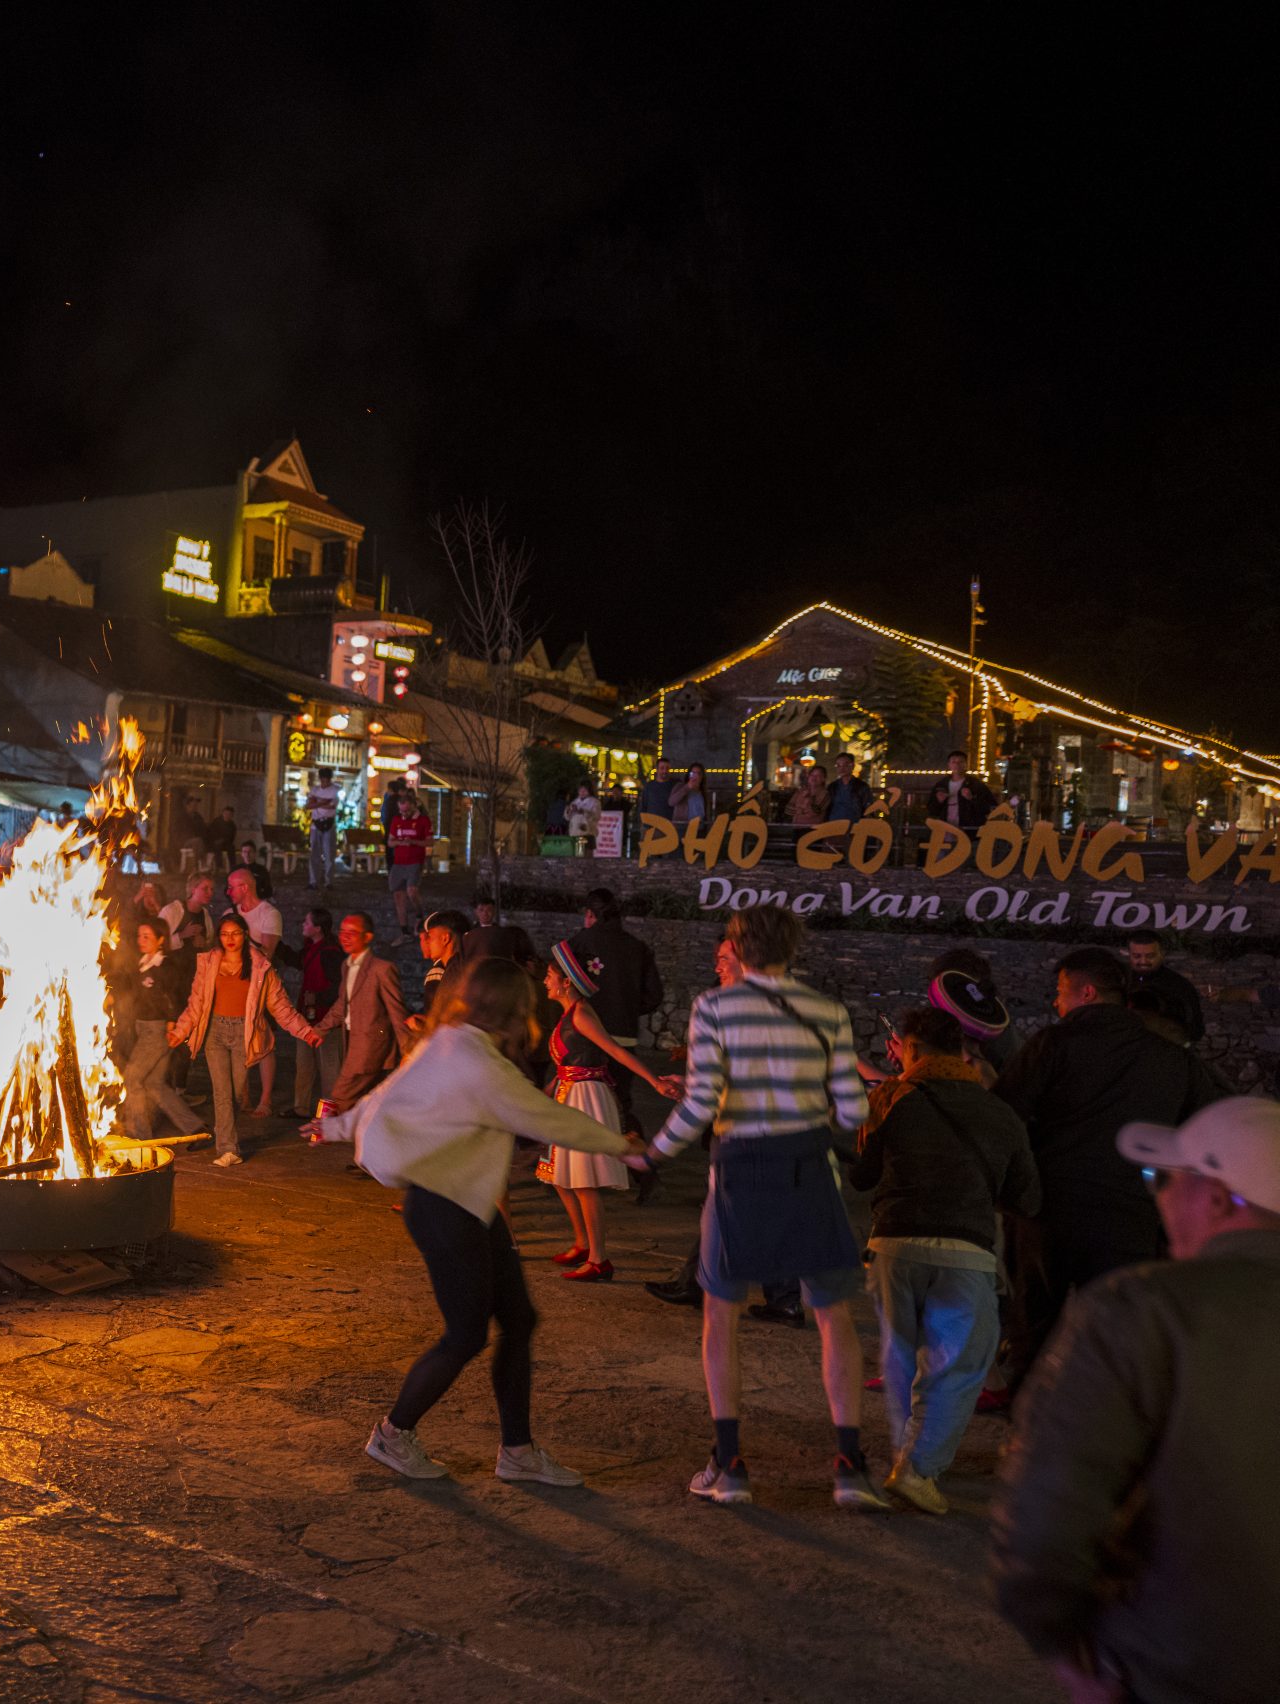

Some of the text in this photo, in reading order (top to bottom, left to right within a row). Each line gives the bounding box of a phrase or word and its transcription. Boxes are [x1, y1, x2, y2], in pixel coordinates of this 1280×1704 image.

[638, 780, 768, 870] PHỐ
[796, 787, 902, 876] CỔ
[839, 882, 944, 920] Van
[965, 886, 1071, 925] Old
[1089, 891, 1252, 933] Town
